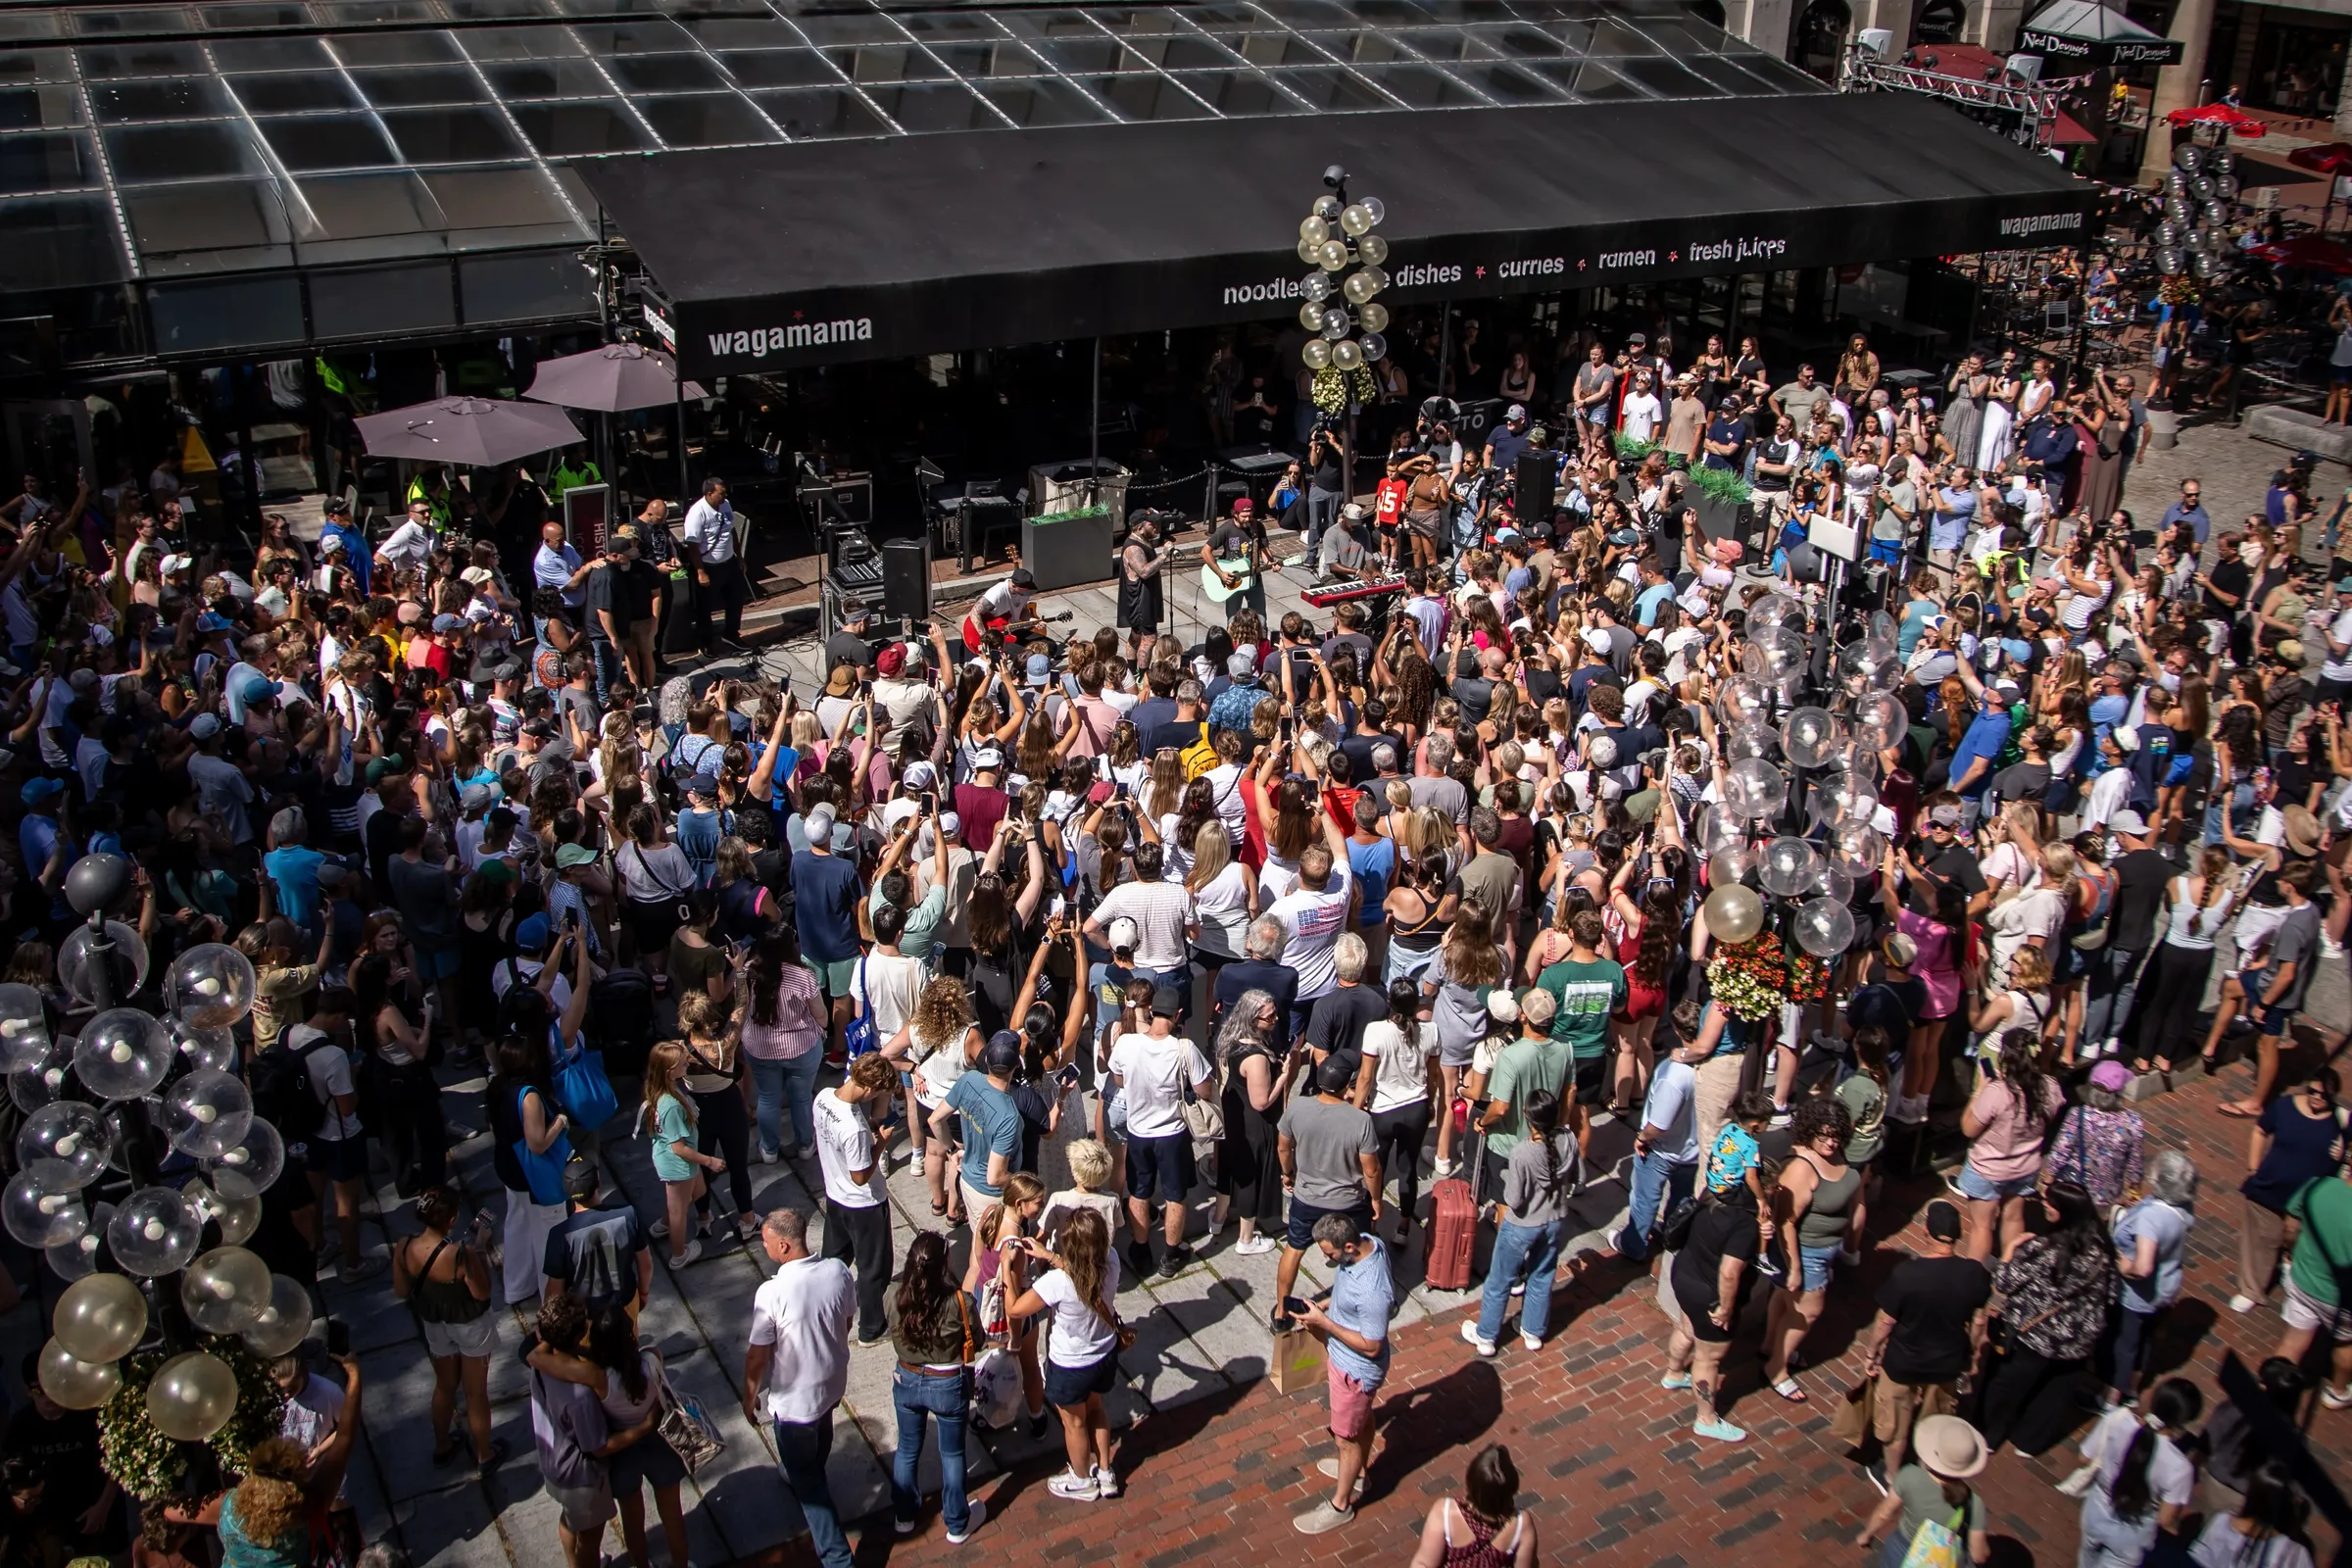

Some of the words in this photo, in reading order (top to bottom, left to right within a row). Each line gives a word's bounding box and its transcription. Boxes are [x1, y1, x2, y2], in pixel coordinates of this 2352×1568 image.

[2001, 213, 2082, 237] wagamama
[1396, 263, 1462, 287] dishes
[1498, 256, 1565, 279] curries
[1598, 247, 1656, 270] ramen
[1689, 238, 1733, 263] fresh
[708, 317, 873, 358] wagamama
[1379, 490, 1398, 514] 15
